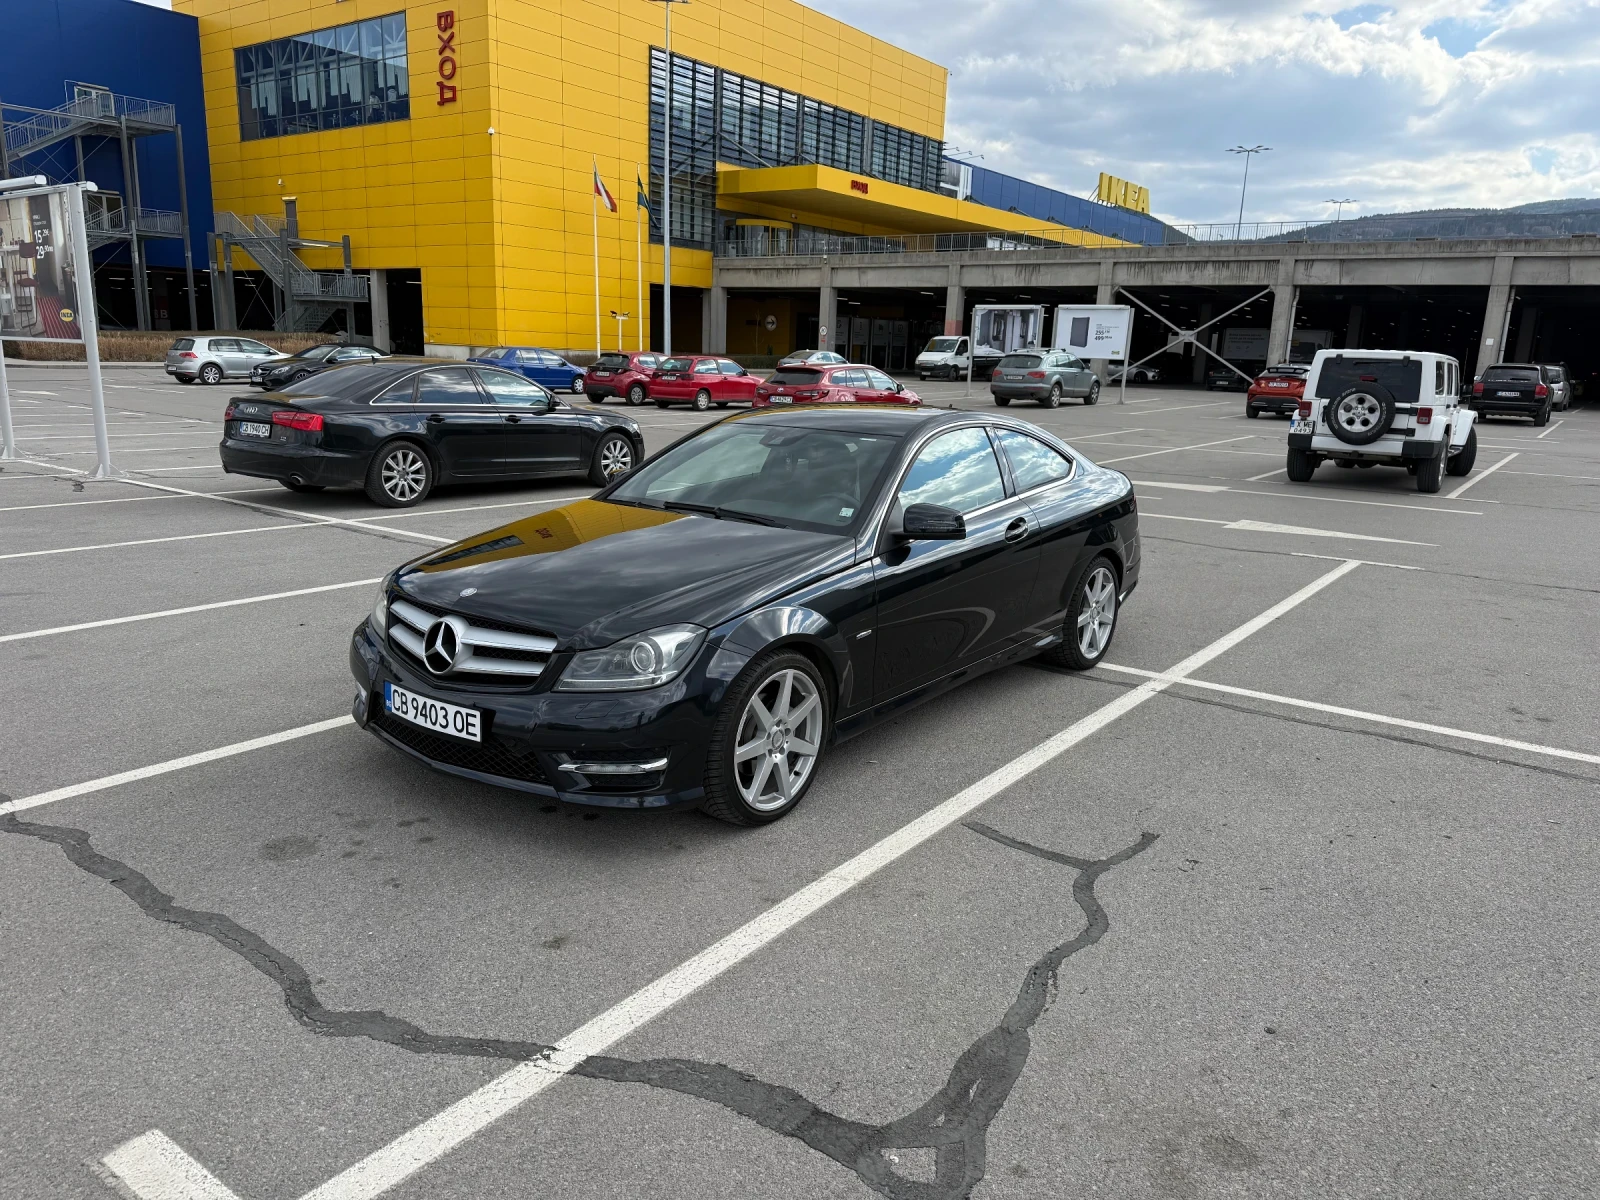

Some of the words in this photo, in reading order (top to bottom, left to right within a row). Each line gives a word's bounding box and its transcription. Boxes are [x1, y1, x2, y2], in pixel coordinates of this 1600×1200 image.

[437, 10, 457, 106] ВХОД
[1098, 172, 1150, 214] IKEA
[34, 229, 43, 243] 15
[36, 245, 44, 259] 29
[243, 423, 249, 432] CB
[249, 423, 261, 433] 1940
[392, 689, 409, 716] CB
[411, 697, 449, 729] 9403
[453, 710, 478, 738] OE
